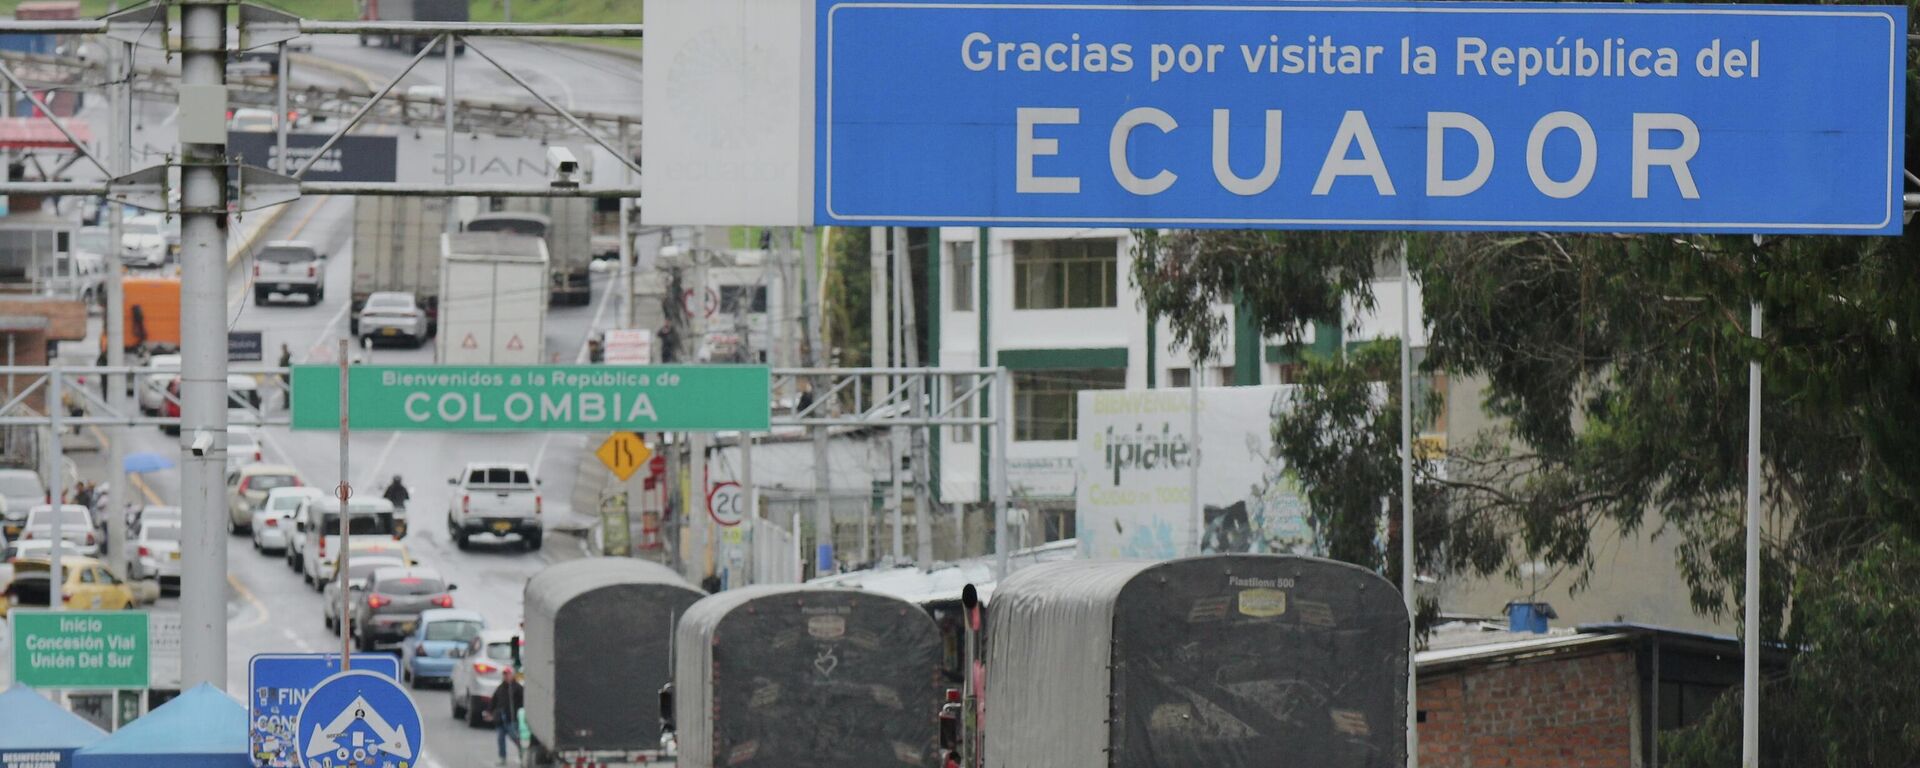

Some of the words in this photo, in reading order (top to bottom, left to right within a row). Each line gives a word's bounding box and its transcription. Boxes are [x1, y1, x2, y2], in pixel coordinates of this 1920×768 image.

[962, 32, 1134, 72] Gracias
[1151, 43, 1225, 82] por
[1240, 34, 1384, 75] visitar
[1401, 36, 1437, 75] la
[1456, 36, 1678, 86] República
[1695, 39, 1760, 78] del
[1016, 106, 1701, 199] ECUADOR
[381, 370, 504, 387] Bienvenidos
[509, 375, 522, 387] a
[528, 370, 546, 387] la
[551, 369, 650, 391] República
[655, 371, 681, 387] de
[404, 391, 659, 423] COLOMBIA
[1276, 577, 1295, 588] 500
[60, 617, 103, 633] Inicio
[26, 634, 104, 650] Concesión
[108, 635, 135, 650] Vial
[30, 652, 75, 668] Unión
[78, 652, 104, 668] Del
[107, 652, 134, 668] Sur
[278, 687, 314, 705] FIN
[257, 715, 297, 733] CON
